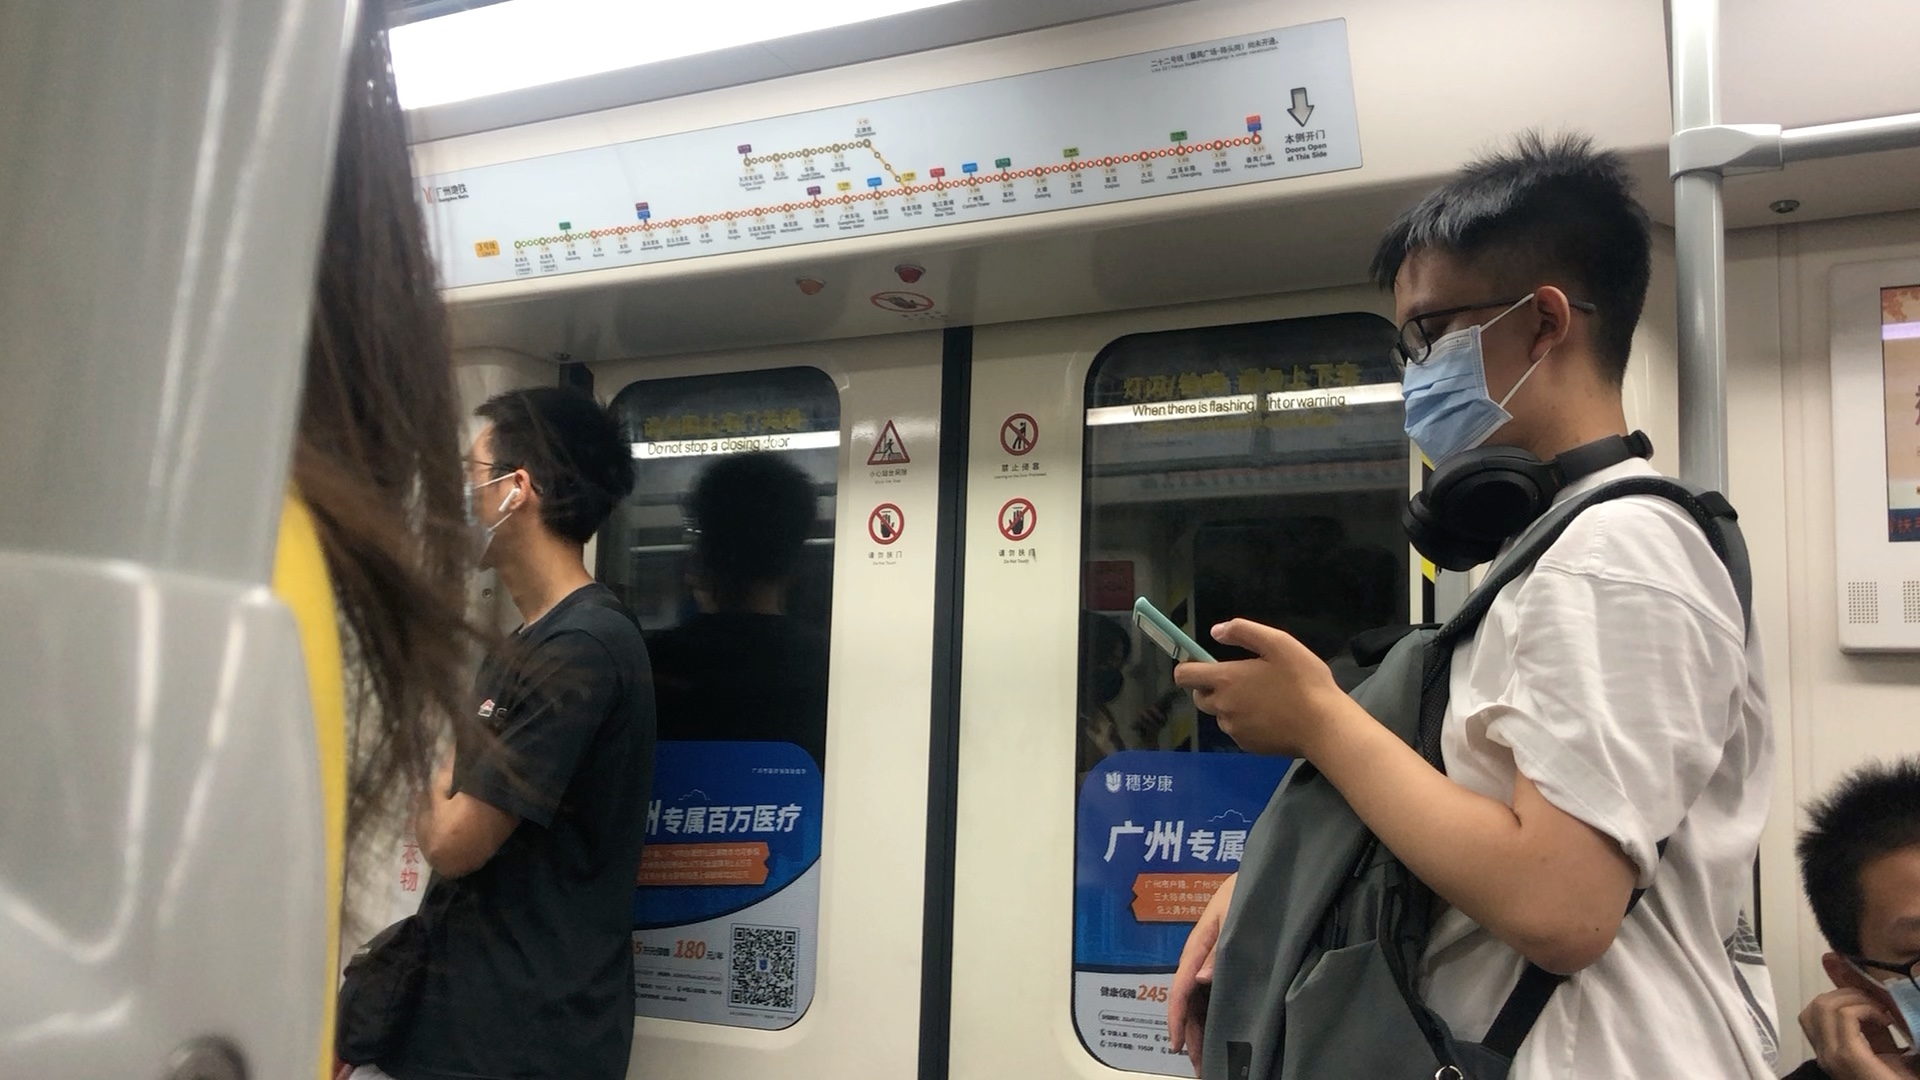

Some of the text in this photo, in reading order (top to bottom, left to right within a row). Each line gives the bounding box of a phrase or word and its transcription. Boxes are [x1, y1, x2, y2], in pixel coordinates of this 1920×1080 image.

[1285, 129, 1326, 144] 本侧开门
[1285, 142, 1327, 154] Doors Open
[1295, 153, 1310, 161] This
[1312, 150, 1327, 159] Side
[1132, 404, 1166, 417] When
[1167, 401, 1197, 415] there
[1198, 401, 1208, 413] is
[1209, 397, 1255, 413] flashing
[1283, 397, 1295, 409] or
[1297, 393, 1345, 409] warning
[647, 441, 664, 455] Do
[665, 441, 683, 454] not
[685, 440, 708, 455] stop
[711, 443, 718, 452] a
[721, 436, 760, 453] closing
[1125, 774, 1174, 792] 穗岁康
[1103, 820, 1248, 863] 广州专属
